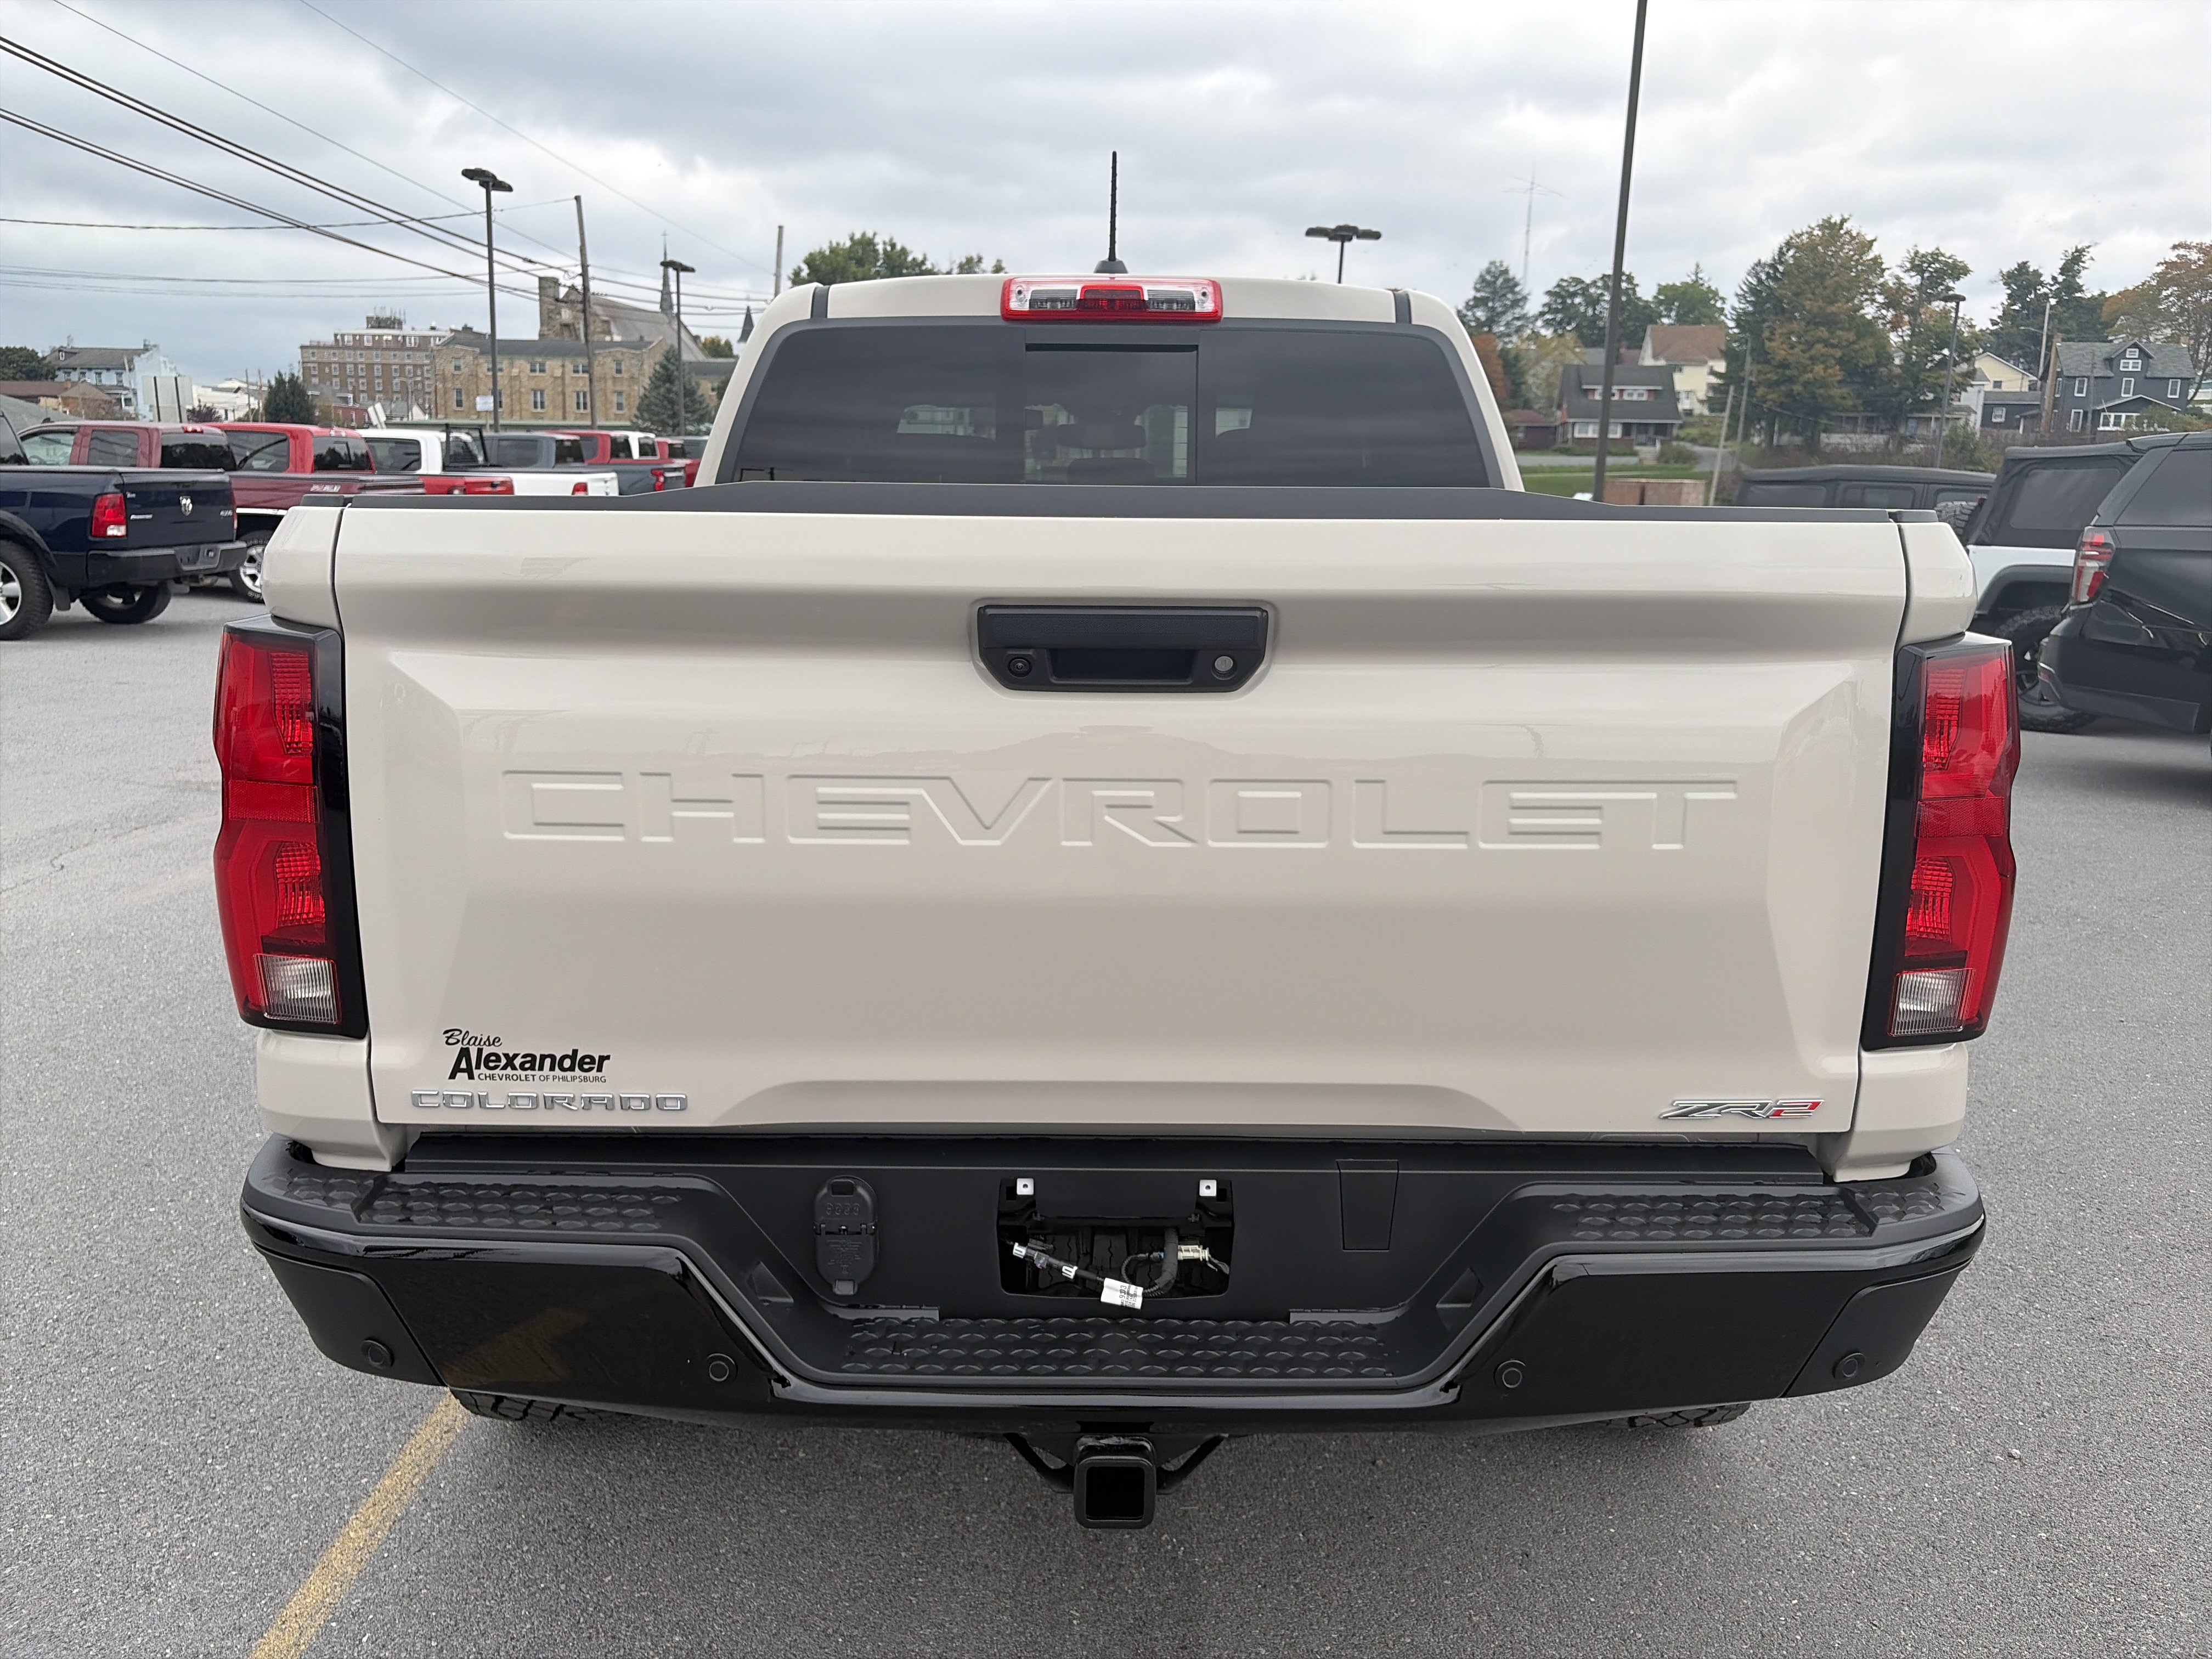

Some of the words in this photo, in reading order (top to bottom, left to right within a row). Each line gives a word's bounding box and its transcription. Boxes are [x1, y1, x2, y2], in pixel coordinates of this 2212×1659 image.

[501, 770, 1738, 850] CHEVROLET
[443, 1029, 503, 1047] Blaise
[448, 1047, 611, 1080] Alexander
[478, 1073, 536, 1082] CHEVROLET
[411, 1090, 687, 1110] COLORADO
[1659, 1099, 1824, 1119] ZR2
